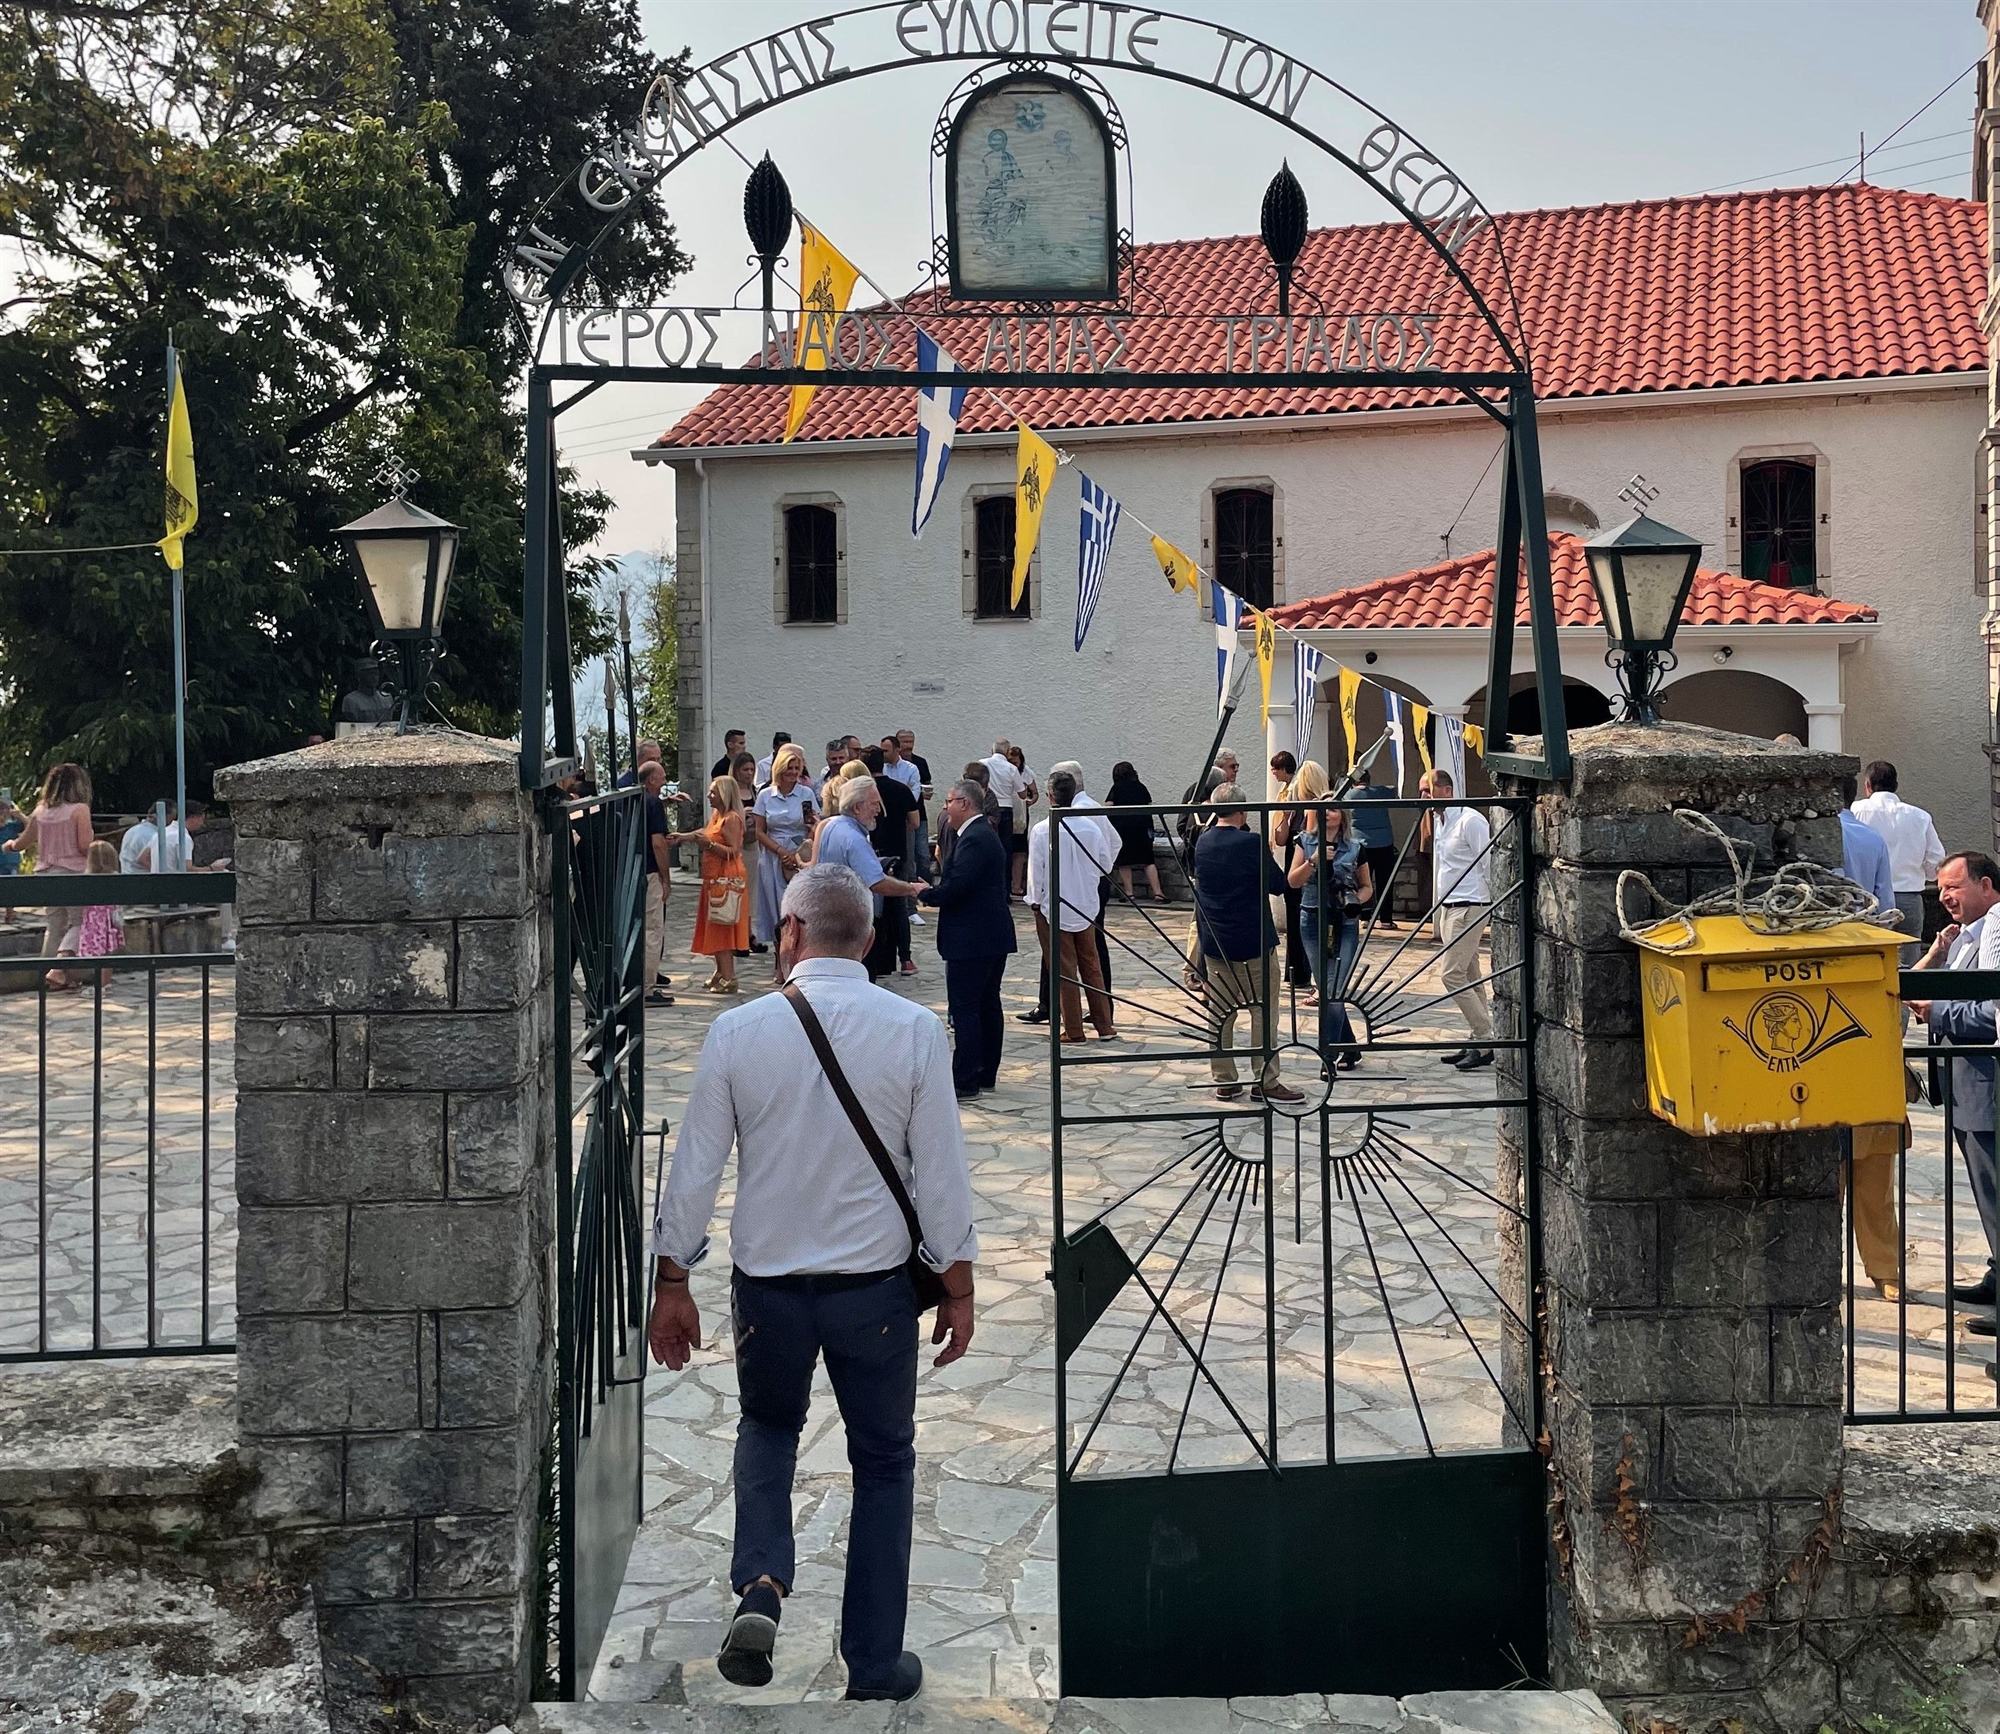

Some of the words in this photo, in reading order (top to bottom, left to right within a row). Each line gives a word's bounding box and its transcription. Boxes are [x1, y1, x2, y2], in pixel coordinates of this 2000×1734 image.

[896, 0, 1161, 68] ΕΥΛΟΓΕΙΤΕ
[1212, 28, 1312, 118] ΤΟΝ
[1358, 123, 1493, 253] ΘΕΟΝ
[558, 308, 723, 368] ΙΕΡΟΣ
[761, 310, 900, 371] ΝΑΟΣ
[982, 316, 1132, 373] ΑΓΙΑΣ
[1215, 316, 1441, 373] ΤΡΙΑΔΟΣ
[1764, 961, 1824, 983] POST
[1768, 1055, 1801, 1073] ΕΛΤΑ
